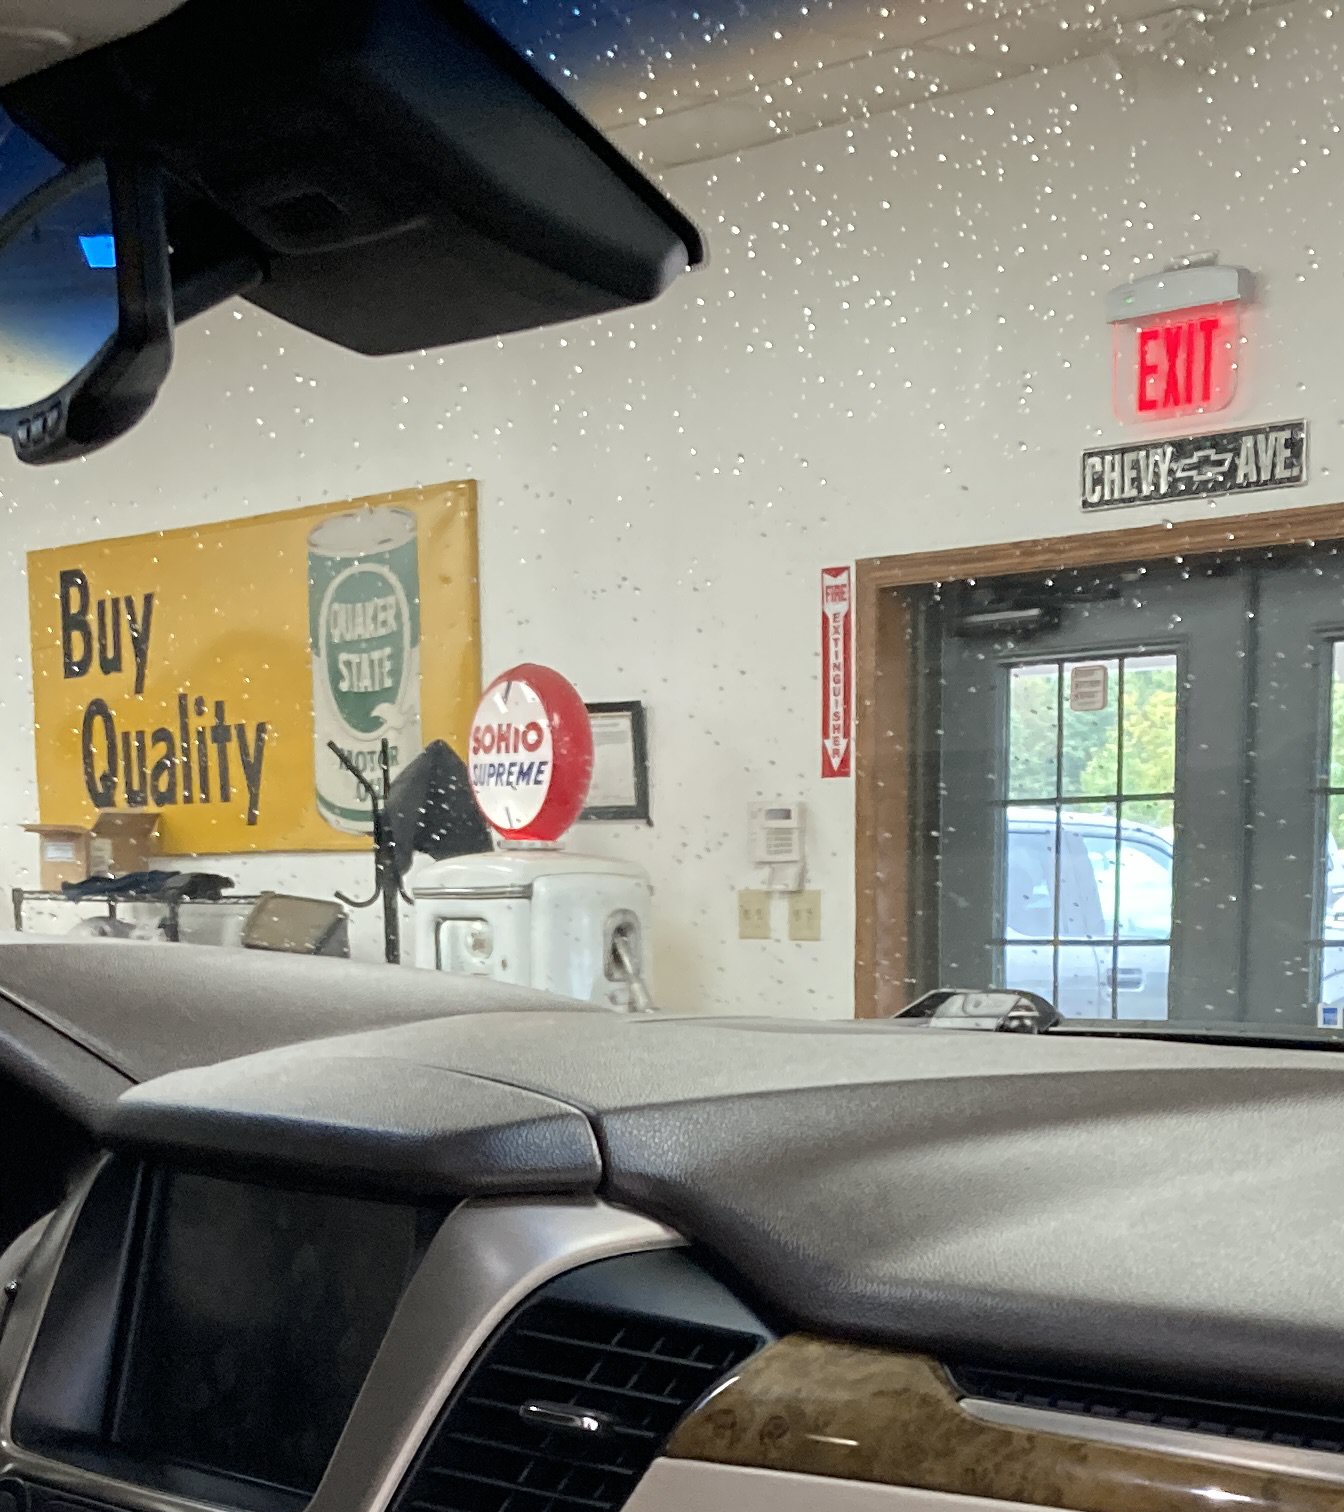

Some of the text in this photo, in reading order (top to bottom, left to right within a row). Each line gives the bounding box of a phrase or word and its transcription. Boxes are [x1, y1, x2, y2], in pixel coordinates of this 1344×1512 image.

[1139, 319, 1219, 411] EXIT
[1085, 445, 1175, 503] CHEVY
[331, 595, 398, 644] QUAKER
[825, 584, 848, 603] FIRE
[60, 568, 155, 694] Buy
[338, 647, 393, 693] STATE
[831, 612, 842, 759] EXTINGUISHER
[82, 693, 267, 826] Quality
[472, 721, 544, 755] SOHIO
[473, 761, 549, 787] SUPREME
